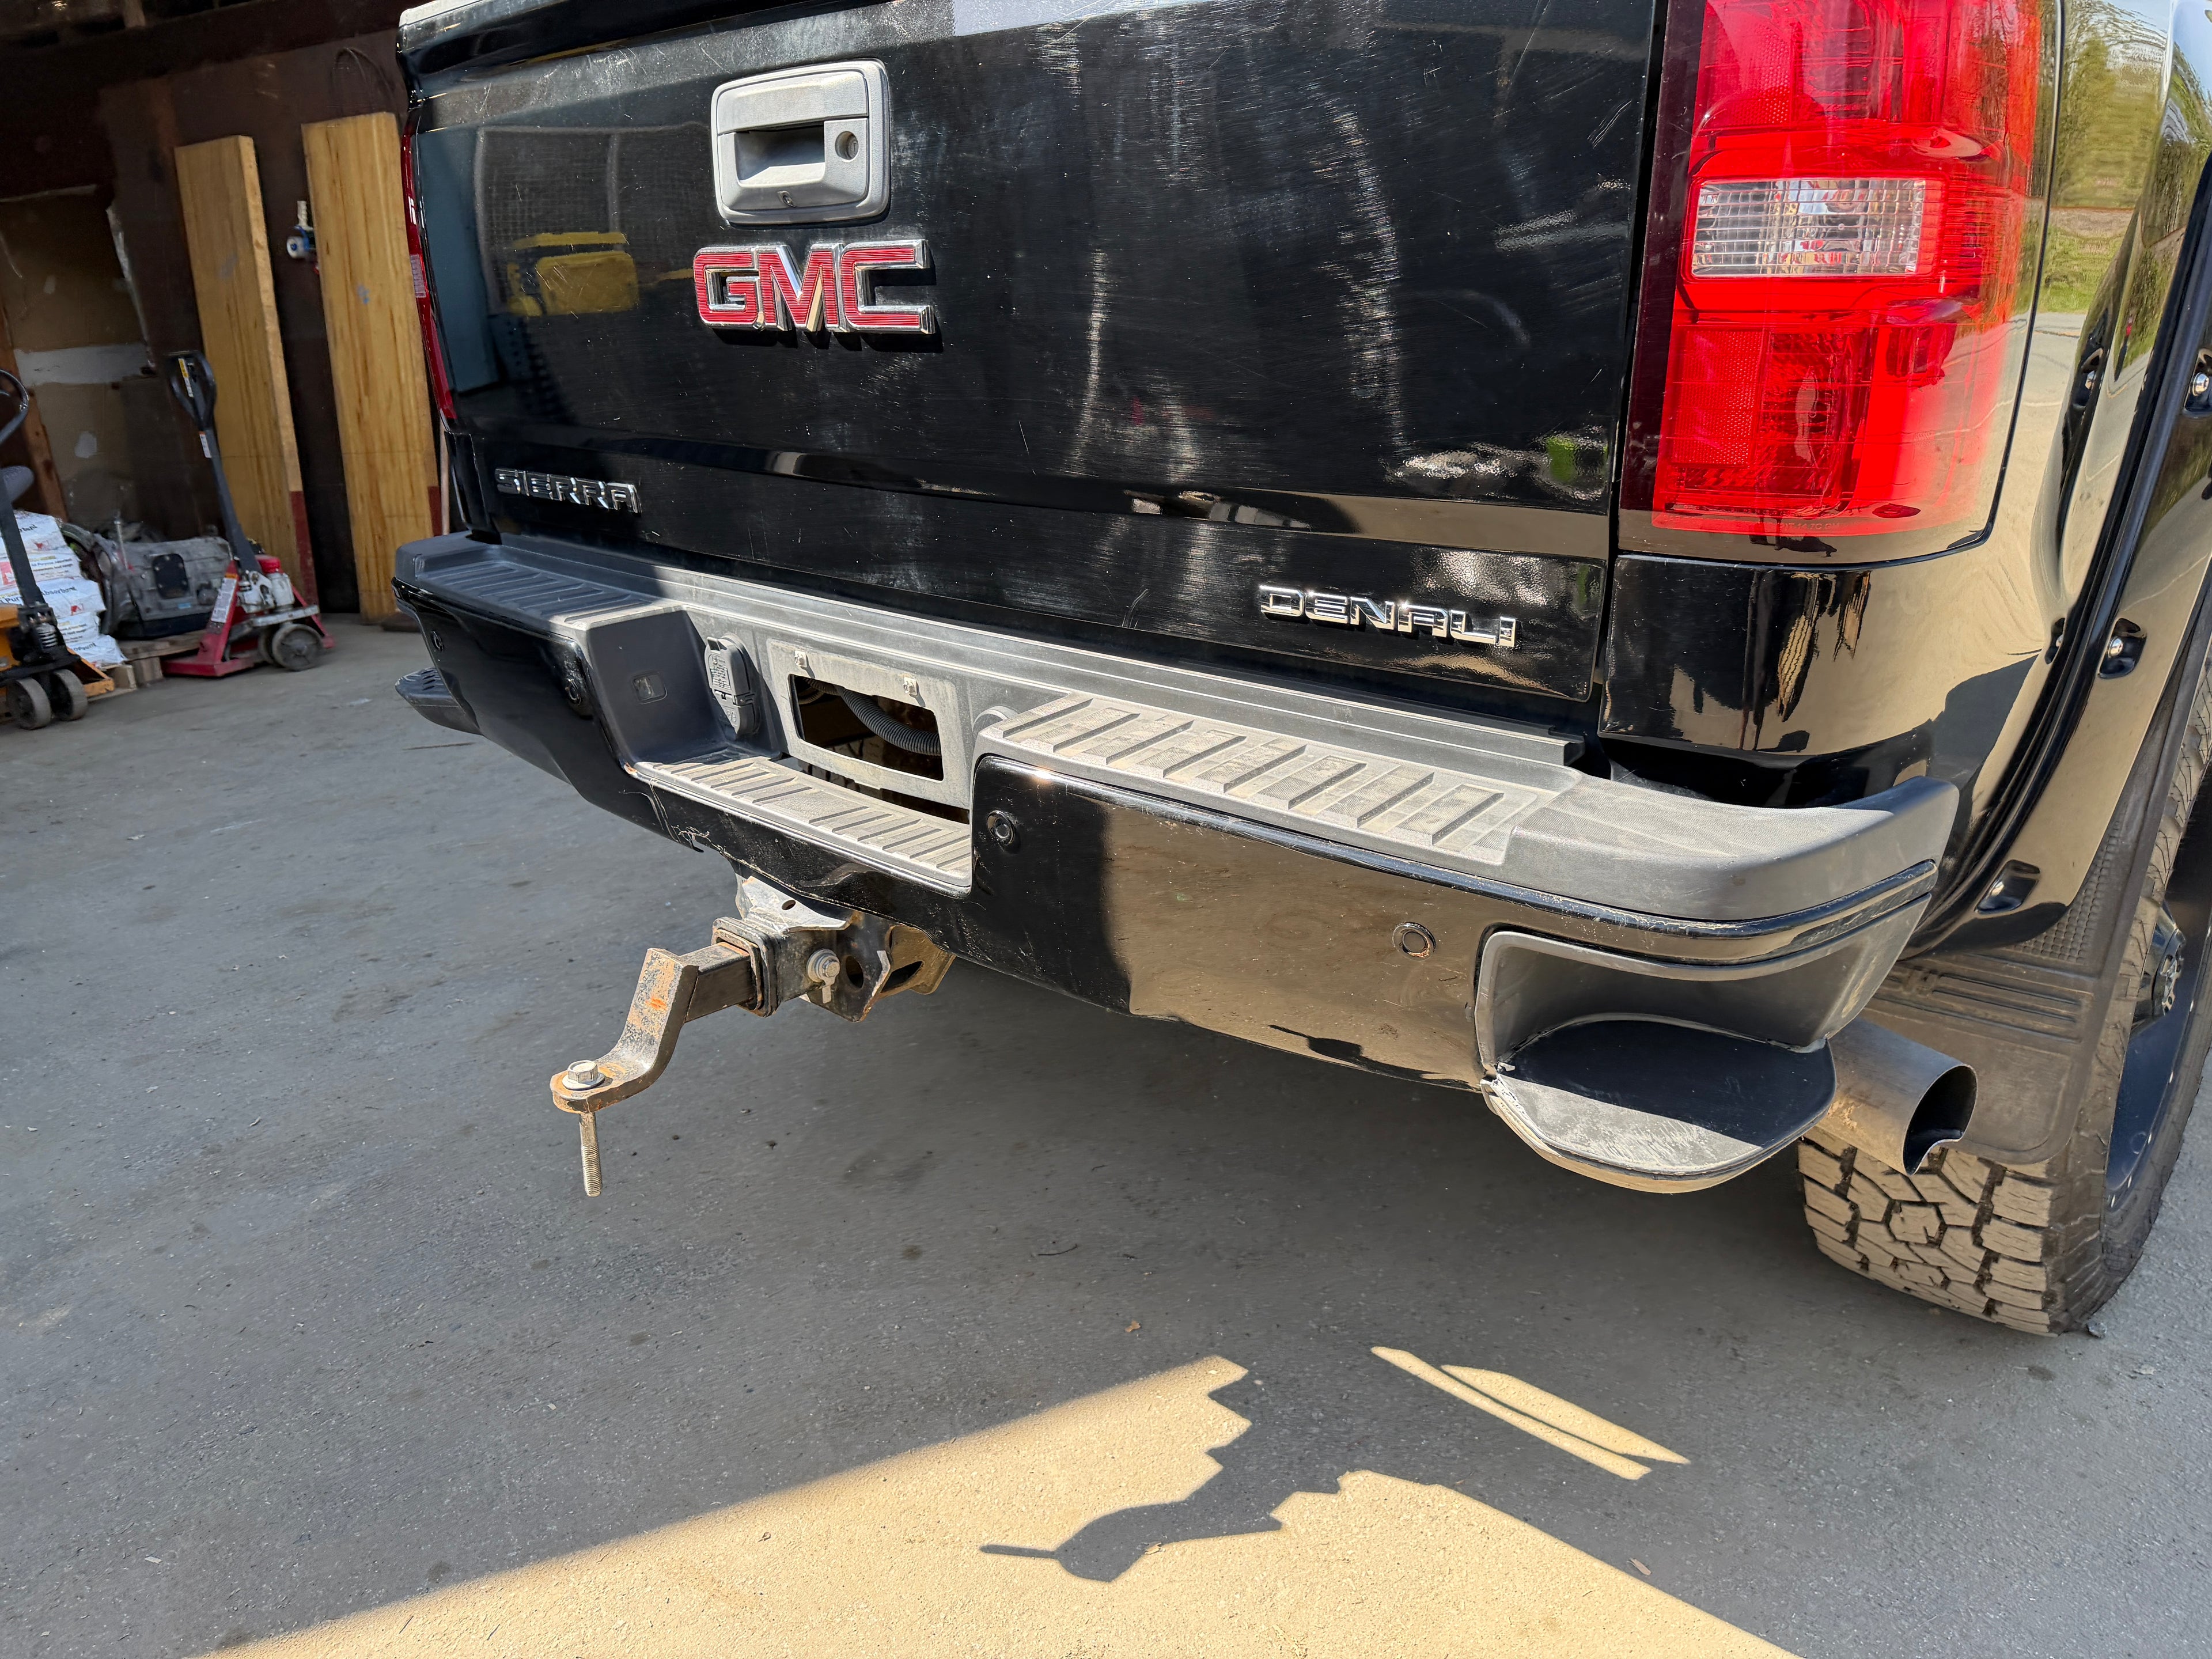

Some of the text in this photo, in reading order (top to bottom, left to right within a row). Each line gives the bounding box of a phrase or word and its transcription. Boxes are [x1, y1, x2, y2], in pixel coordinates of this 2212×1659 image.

[694, 238, 935, 335] GMC
[495, 467, 642, 513] SIERRA
[1260, 585, 1517, 647] DENALI
